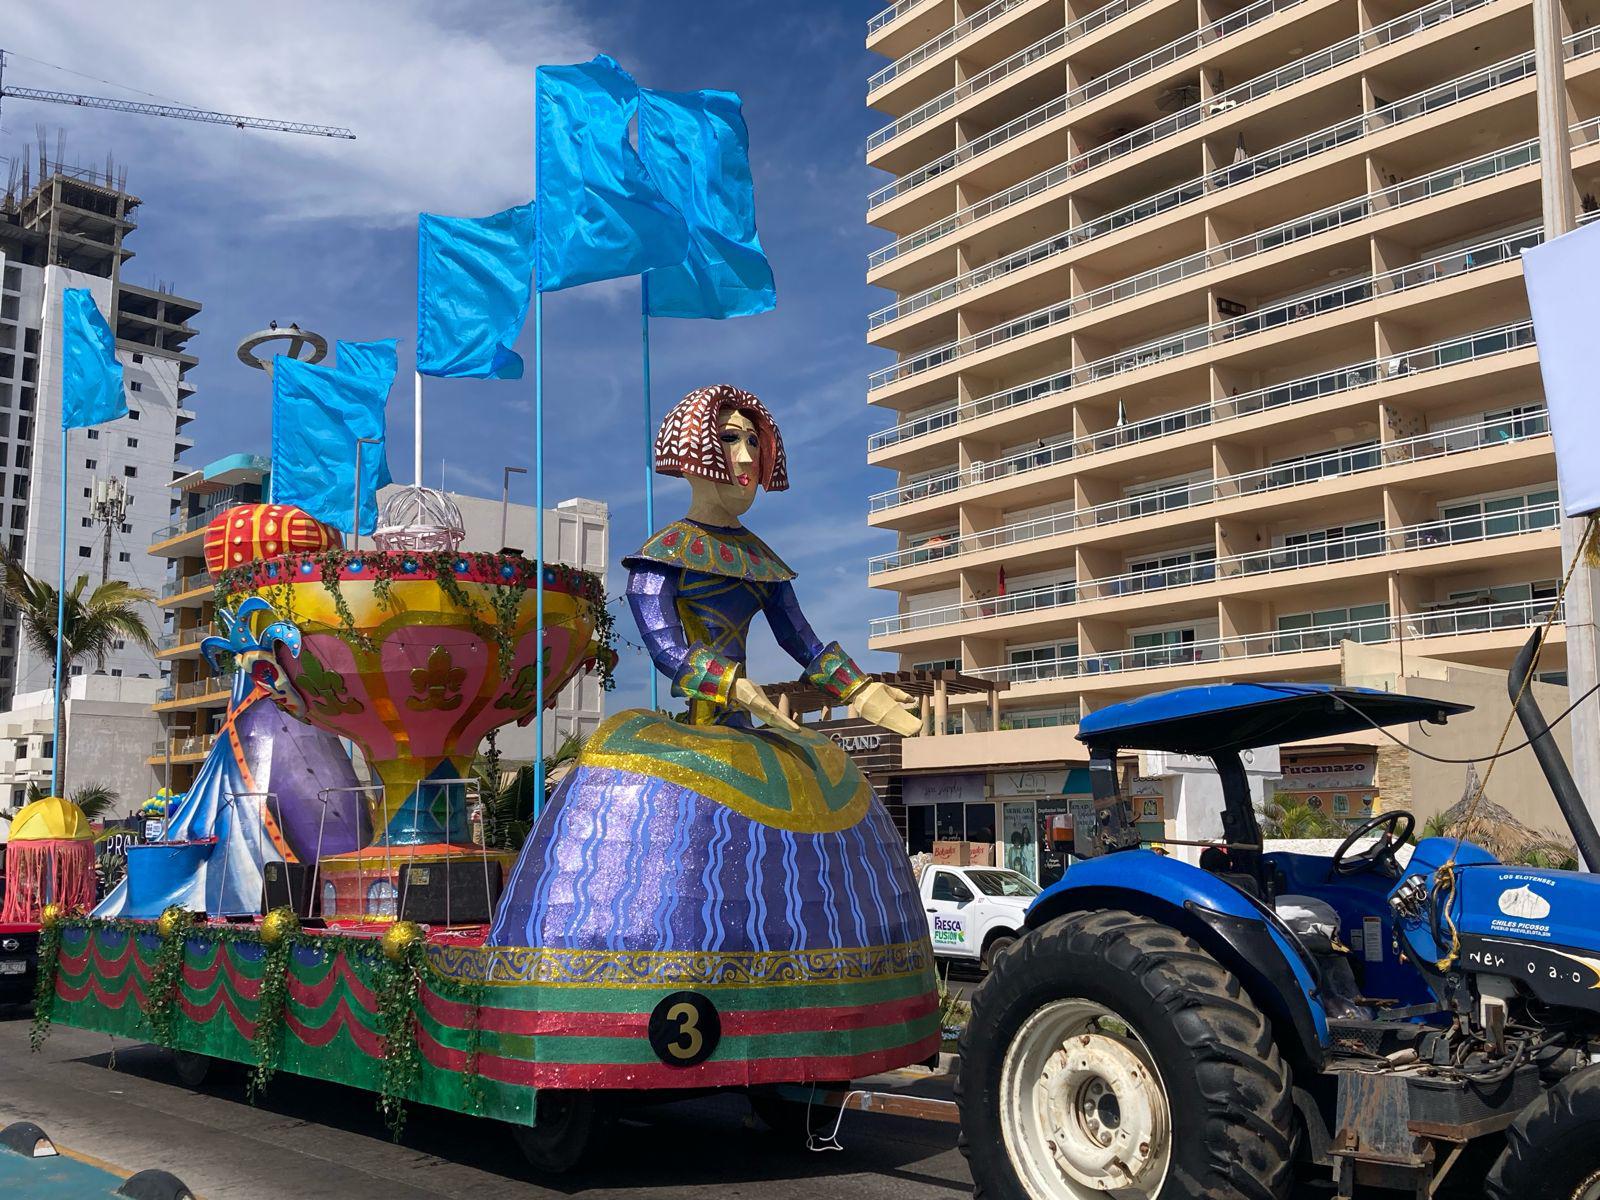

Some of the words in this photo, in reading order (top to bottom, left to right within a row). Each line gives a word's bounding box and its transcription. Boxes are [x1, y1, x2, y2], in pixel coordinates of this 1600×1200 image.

[1281, 763, 1366, 775] Tucanazo
[1515, 875, 1556, 886] ELOTENSES
[934, 916, 962, 932] FRESCA
[1491, 919, 1517, 928] CHILES
[1517, 922, 1550, 932] PICOSOS
[666, 1002, 703, 1059] 3
